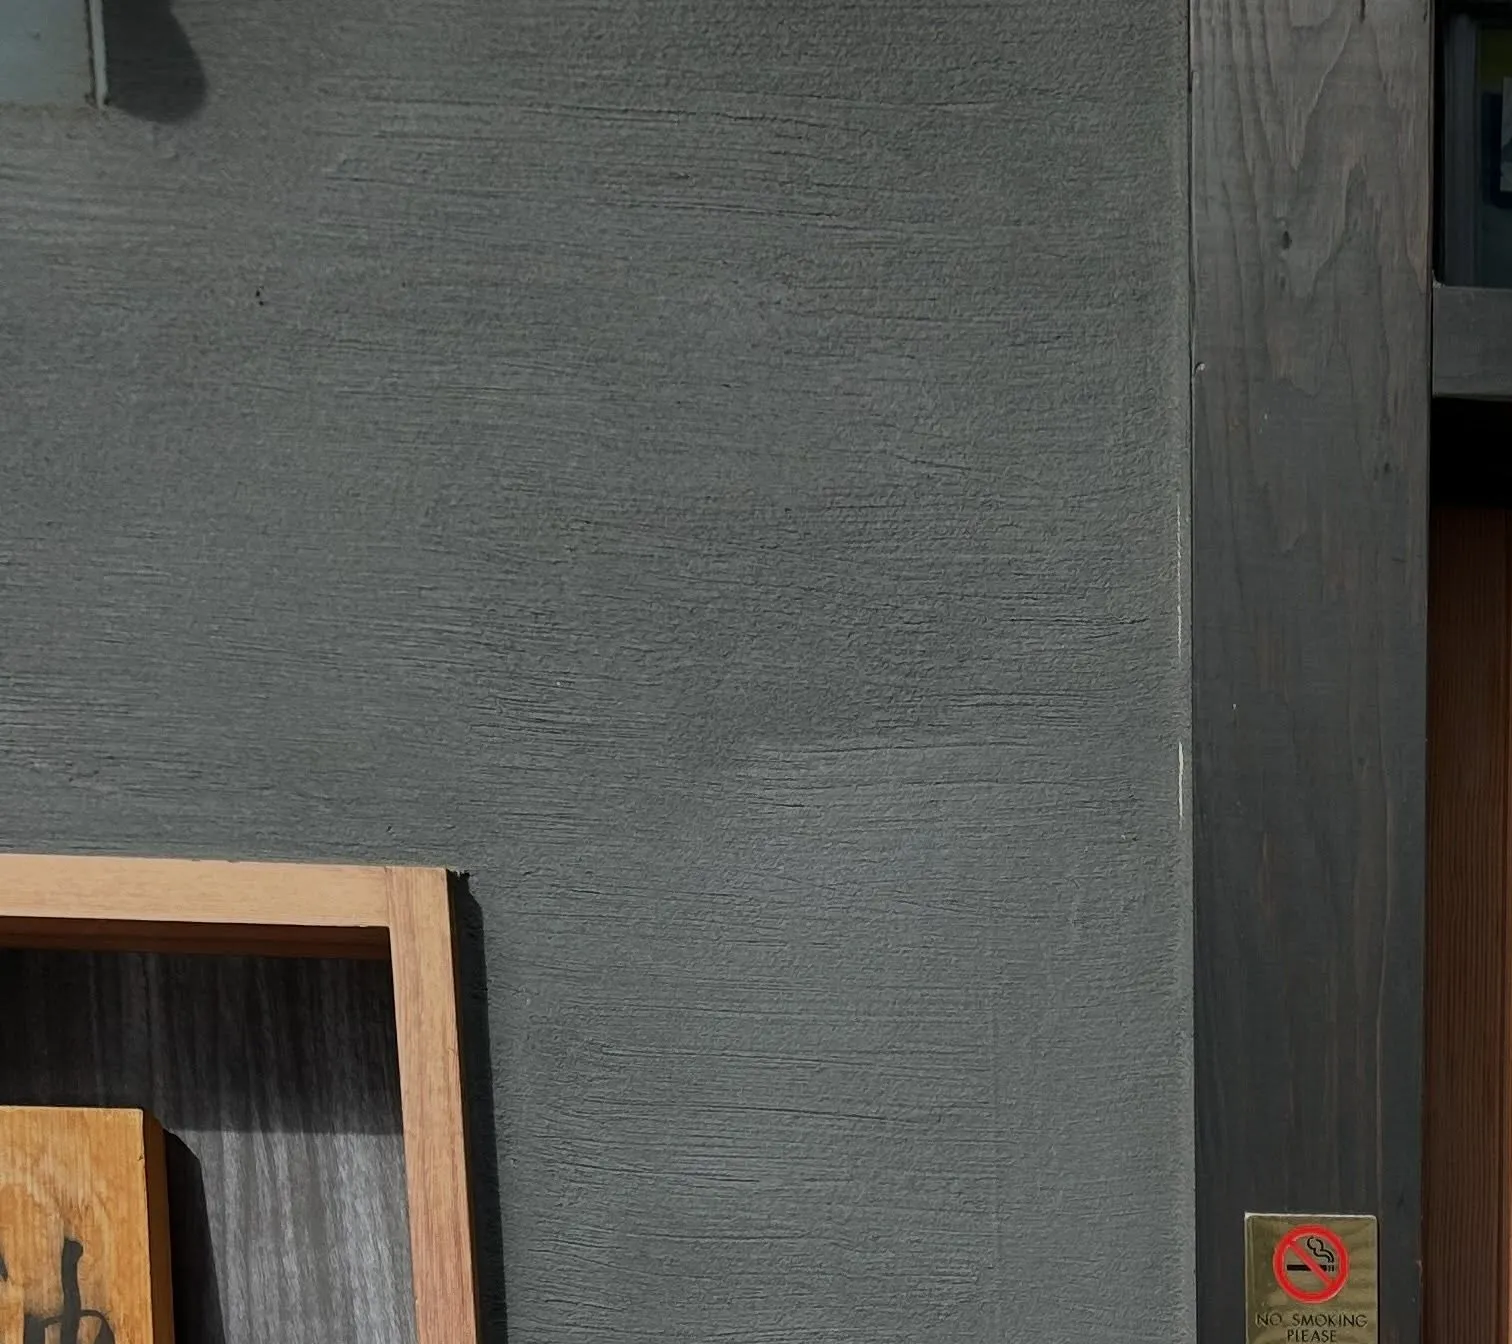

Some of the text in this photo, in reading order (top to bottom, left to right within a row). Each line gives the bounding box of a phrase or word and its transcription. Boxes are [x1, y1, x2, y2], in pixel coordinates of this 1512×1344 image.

[1255, 1312, 1368, 1327] NO SMOKING
[1286, 1329, 1338, 1343] PLEASE
